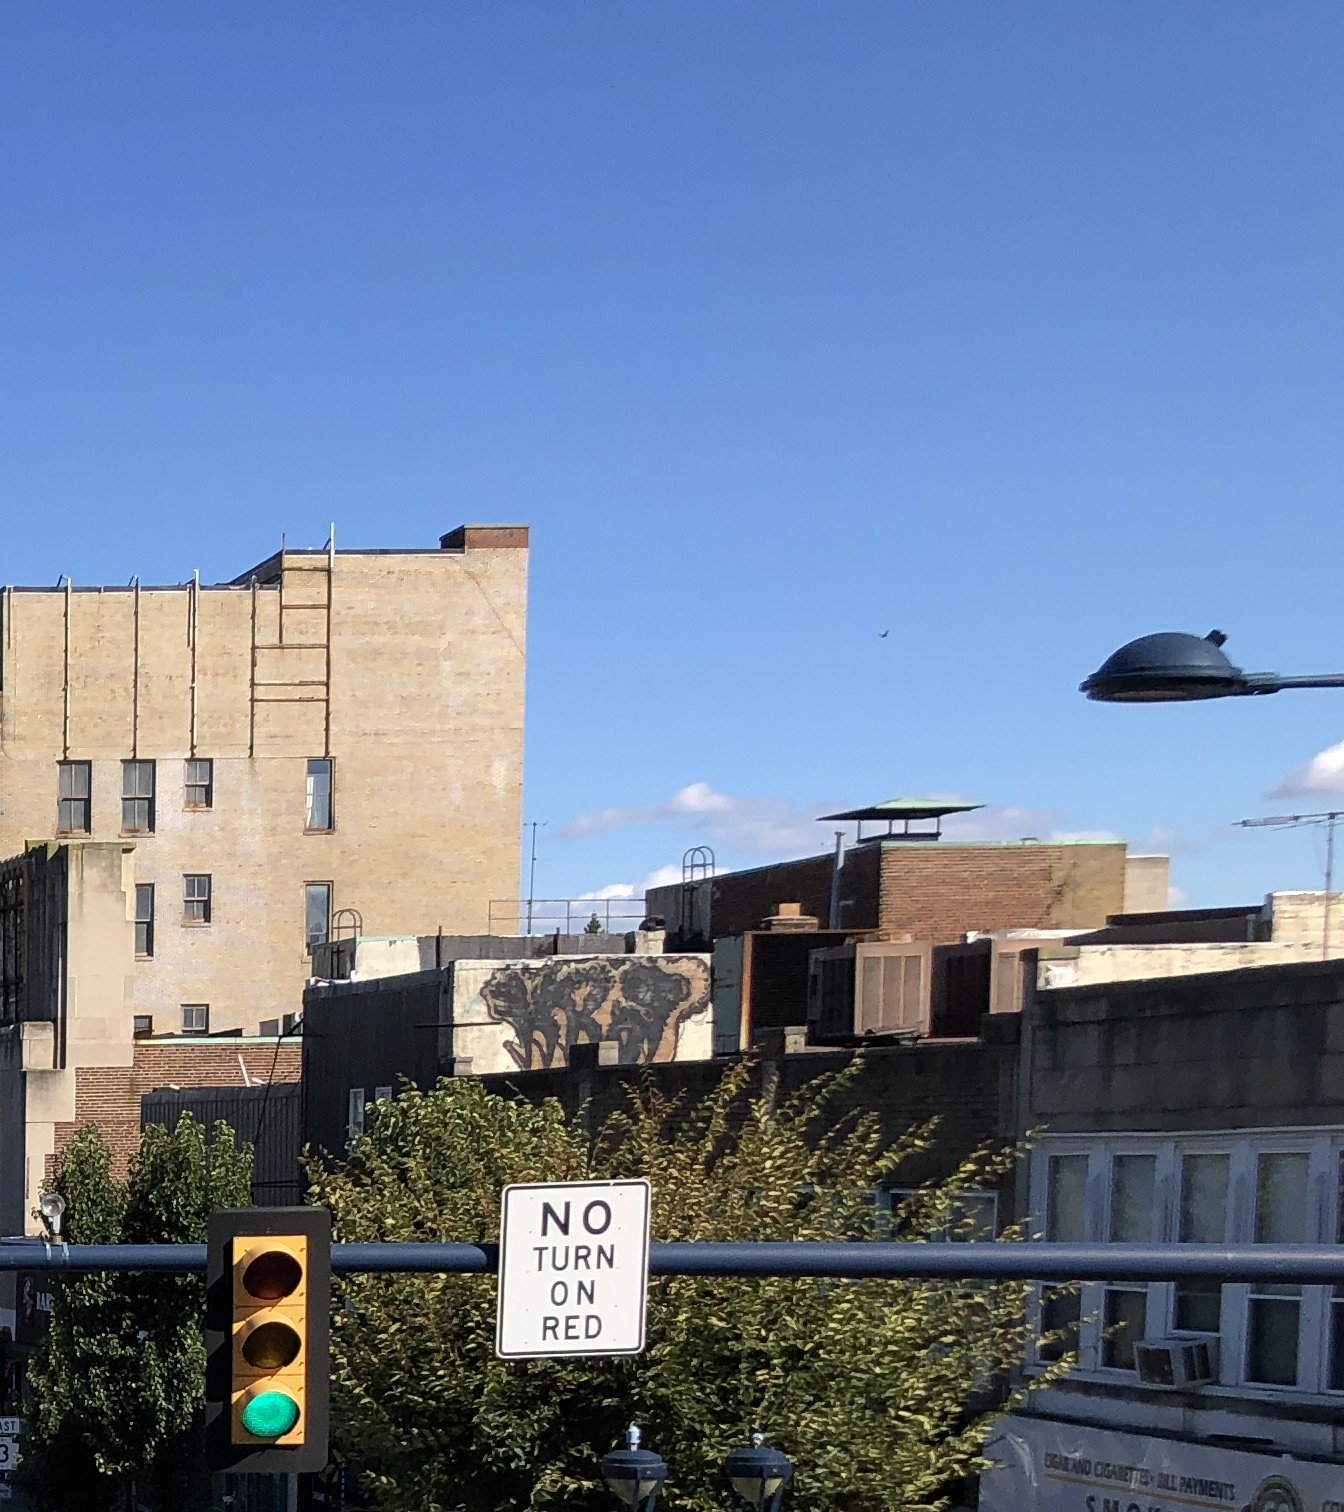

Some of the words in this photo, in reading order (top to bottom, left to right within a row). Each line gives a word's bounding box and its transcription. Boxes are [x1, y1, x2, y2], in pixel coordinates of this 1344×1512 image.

[541, 1200, 612, 1237] NO
[533, 1244, 615, 1272] TURN
[550, 1280, 595, 1306] ON
[542, 1314, 602, 1341] RED
[1157, 1472, 1178, 1492] BILL
[1179, 1476, 1236, 1502] PAYMENTS
